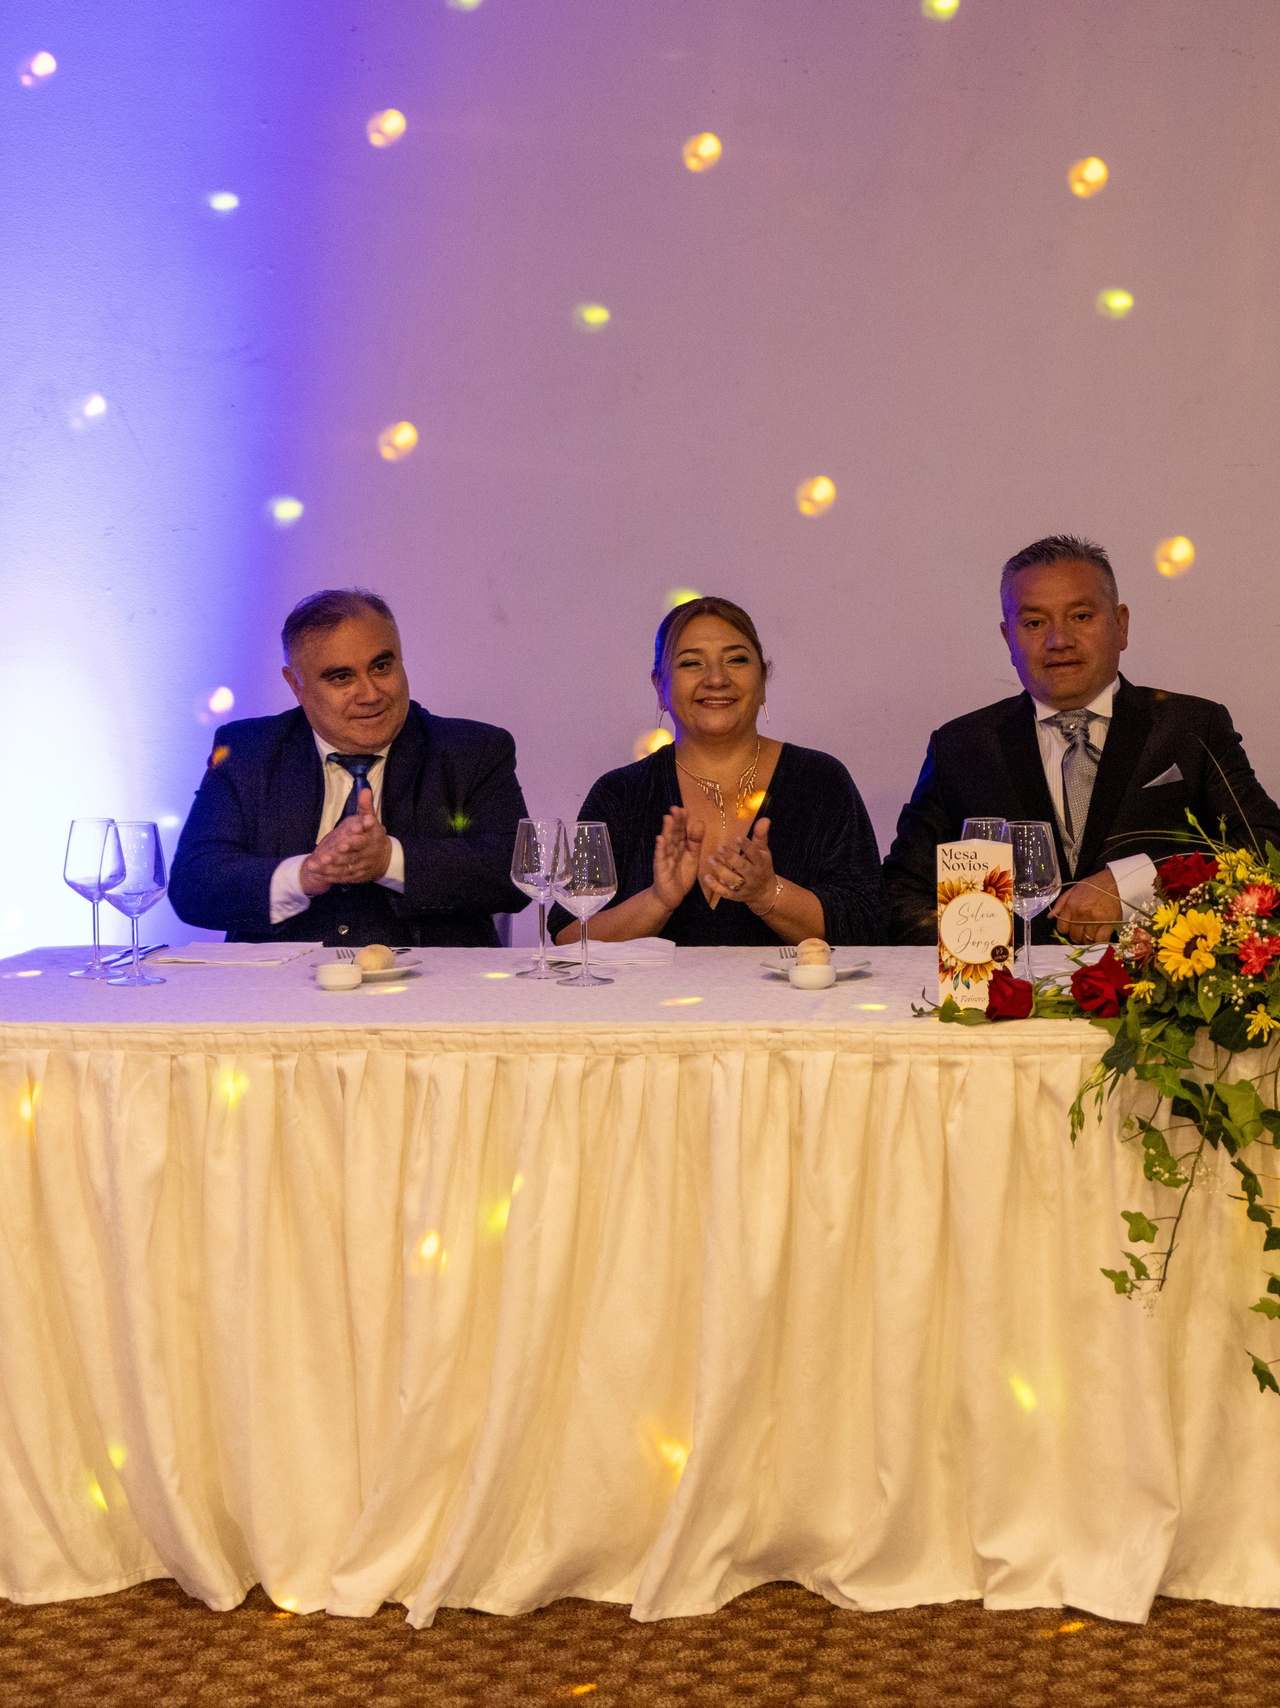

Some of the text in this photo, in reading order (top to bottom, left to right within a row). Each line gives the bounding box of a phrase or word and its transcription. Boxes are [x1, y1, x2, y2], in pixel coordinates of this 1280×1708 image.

[942, 849, 978, 860] Mesa
[942, 860, 989, 871] Novios
[956, 901, 998, 926] Silvia
[954, 928, 998, 953] Jorge
